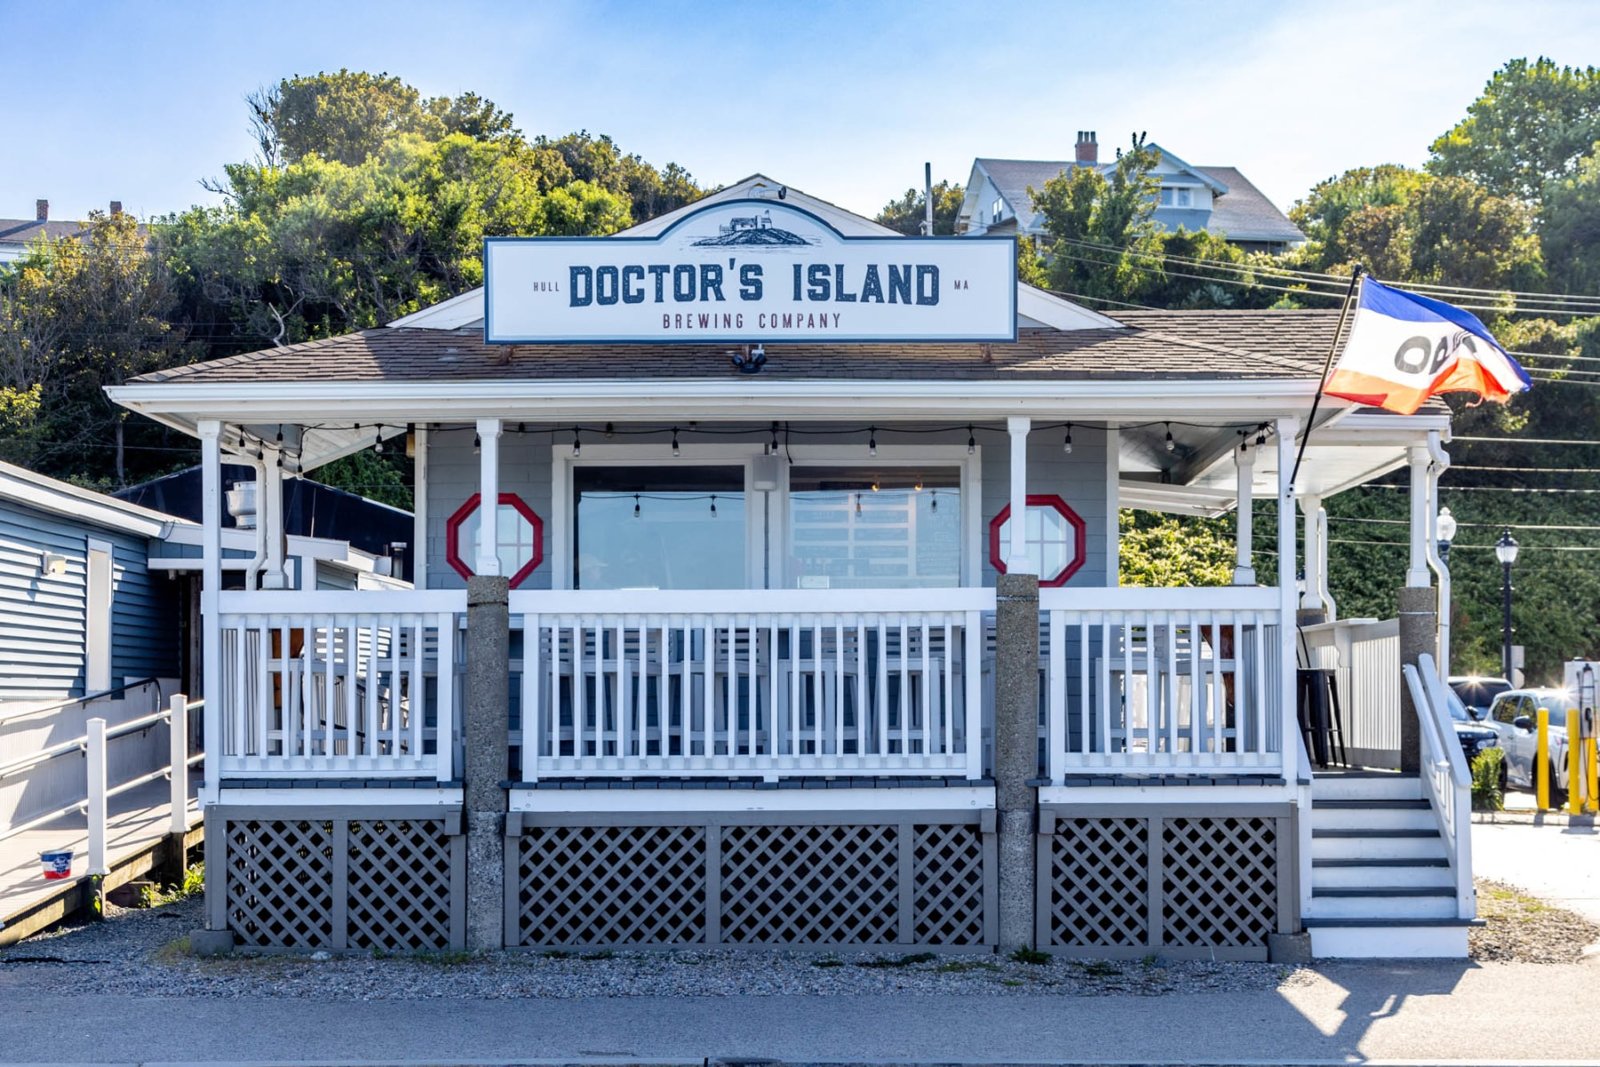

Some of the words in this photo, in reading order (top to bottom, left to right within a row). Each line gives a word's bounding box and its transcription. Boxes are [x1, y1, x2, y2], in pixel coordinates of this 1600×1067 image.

[533, 281, 560, 292] HULL
[568, 257, 766, 308] DOCTOR'S
[791, 263, 940, 306] ISLAND
[953, 279, 969, 290] MA
[662, 312, 743, 329] BREWING
[758, 312, 841, 329] COMPANY
[1394, 331, 1477, 375] OP
